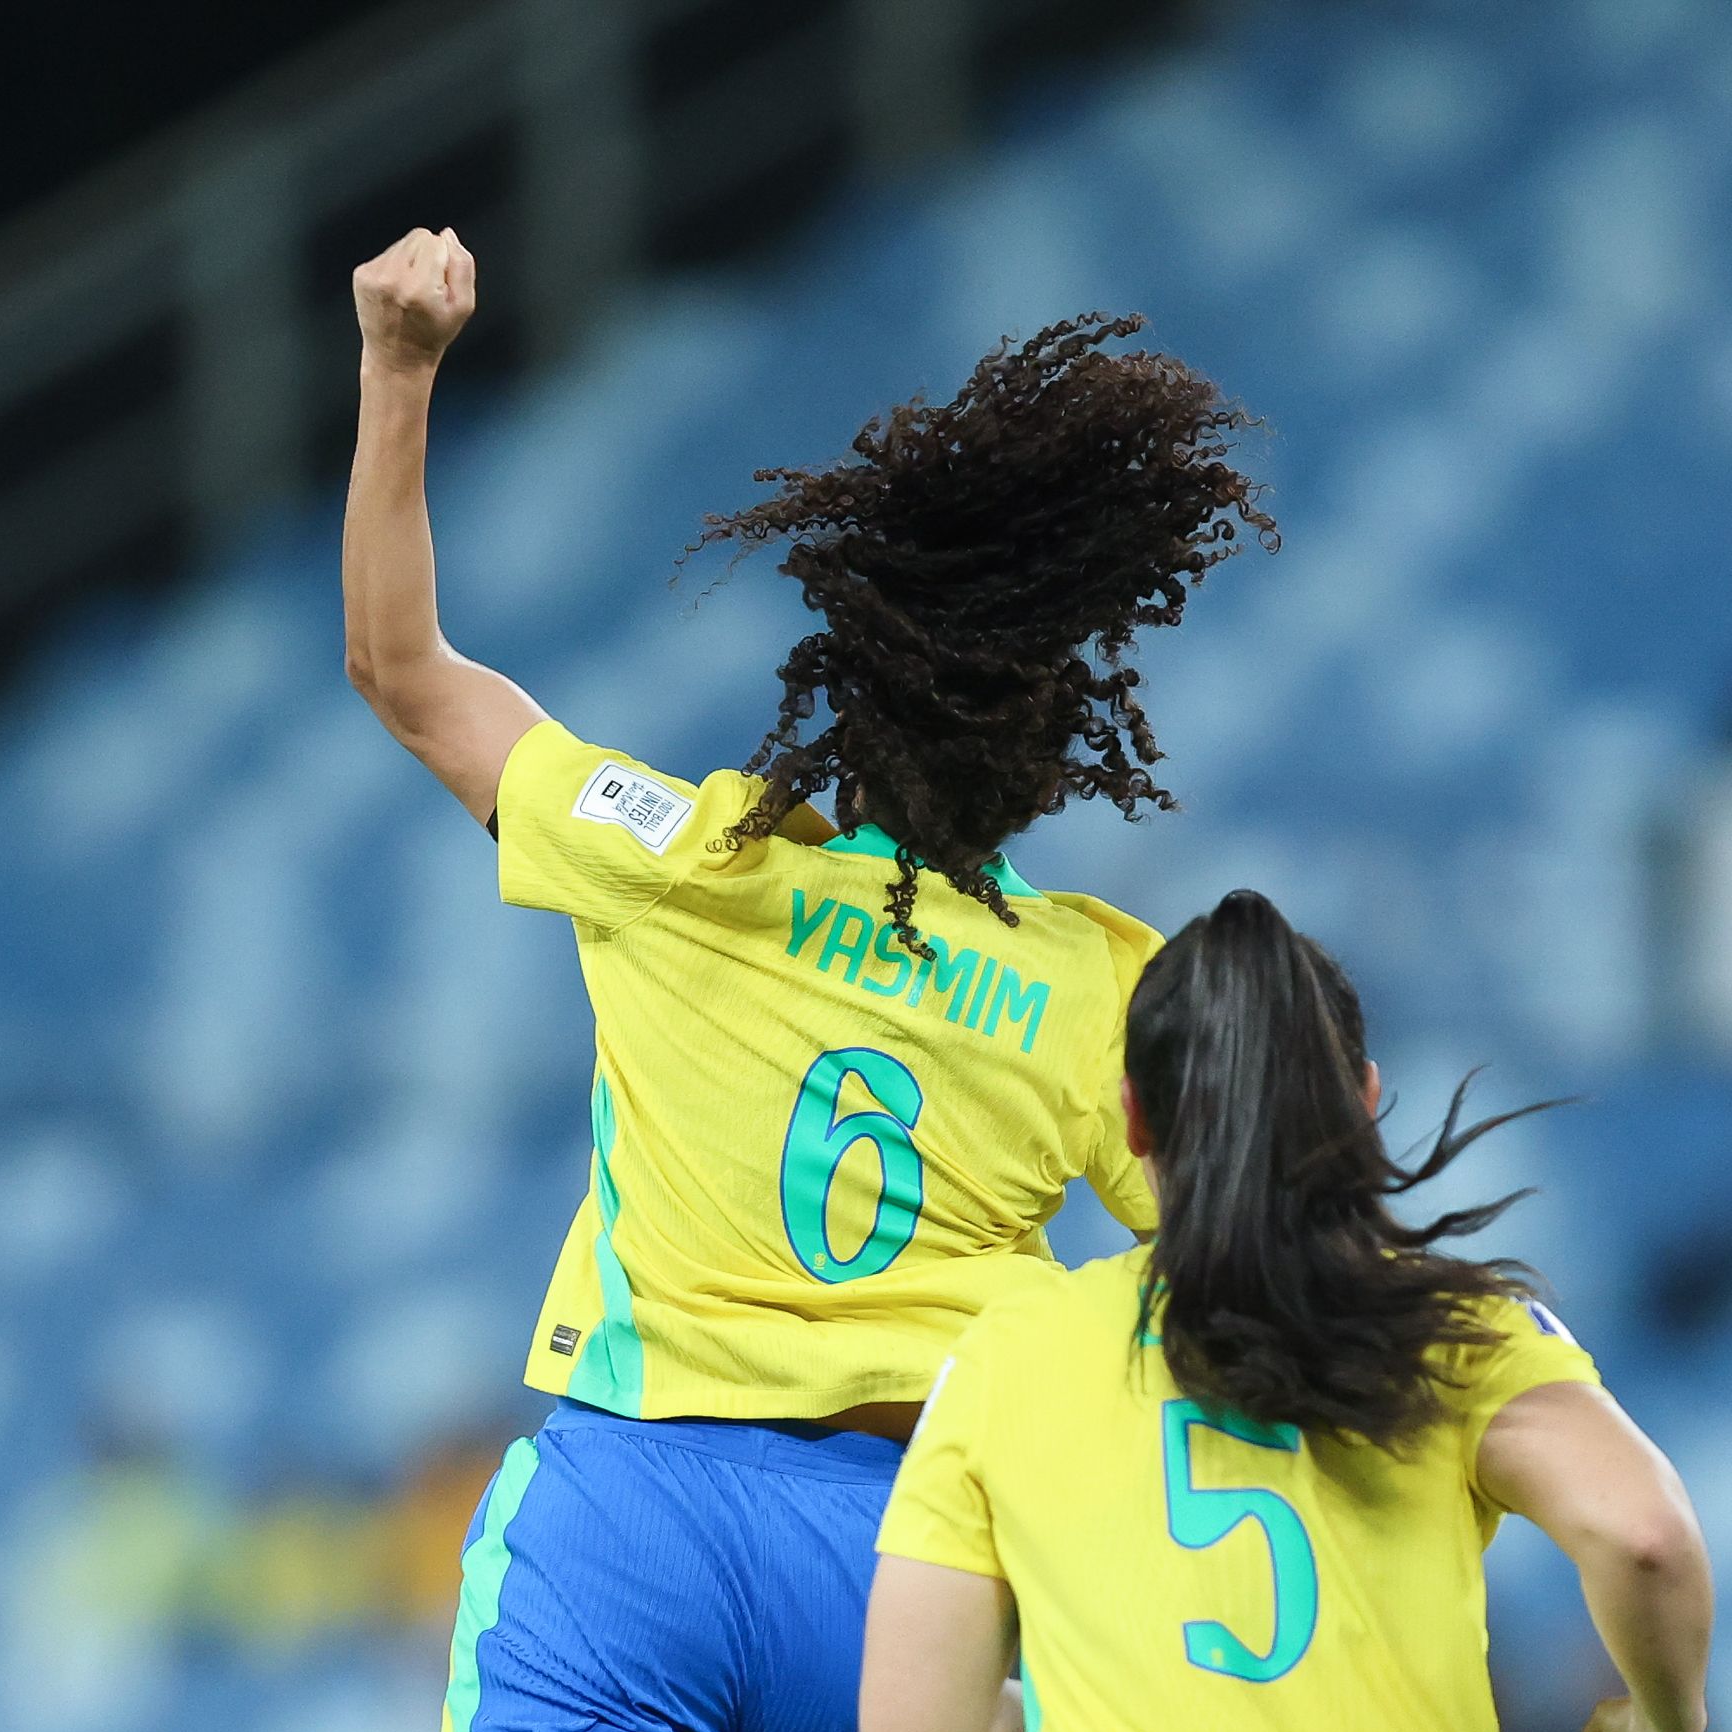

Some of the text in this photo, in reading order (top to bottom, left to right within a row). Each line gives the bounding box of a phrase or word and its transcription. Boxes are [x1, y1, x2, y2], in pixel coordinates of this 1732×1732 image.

[629, 791, 663, 826] UNITES
[644, 799, 675, 832] FOOTBALL
[785, 888, 1051, 1054] YASMIM
[779, 1046, 924, 1285] 6
[1161, 1399, 1319, 1683] 5
